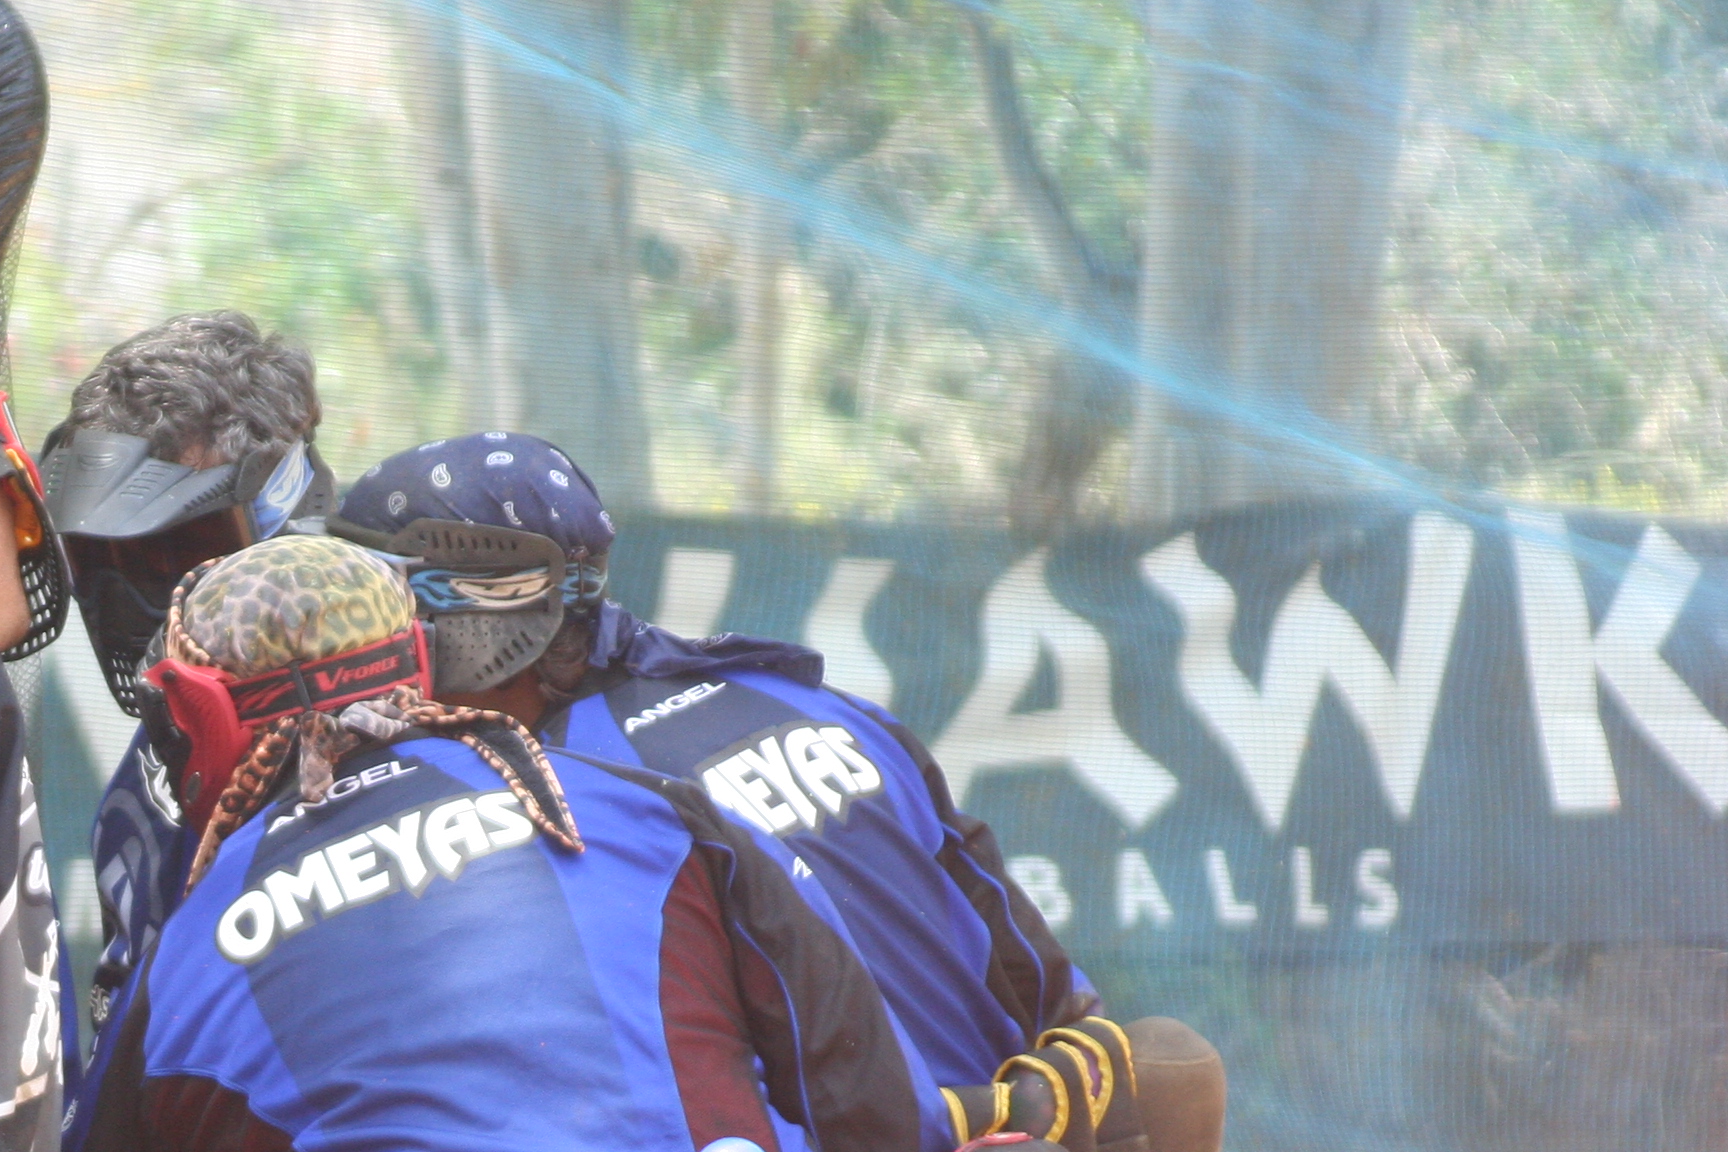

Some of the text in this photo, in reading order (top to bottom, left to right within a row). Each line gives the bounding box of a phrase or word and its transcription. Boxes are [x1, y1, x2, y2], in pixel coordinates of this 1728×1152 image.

[624, 681, 727, 734] ANGEL
[266, 760, 418, 835] ANGEL
[702, 726, 881, 834] MEYAS
[217, 791, 535, 962] OMEYAS
[1005, 846, 1400, 930] BALLS
